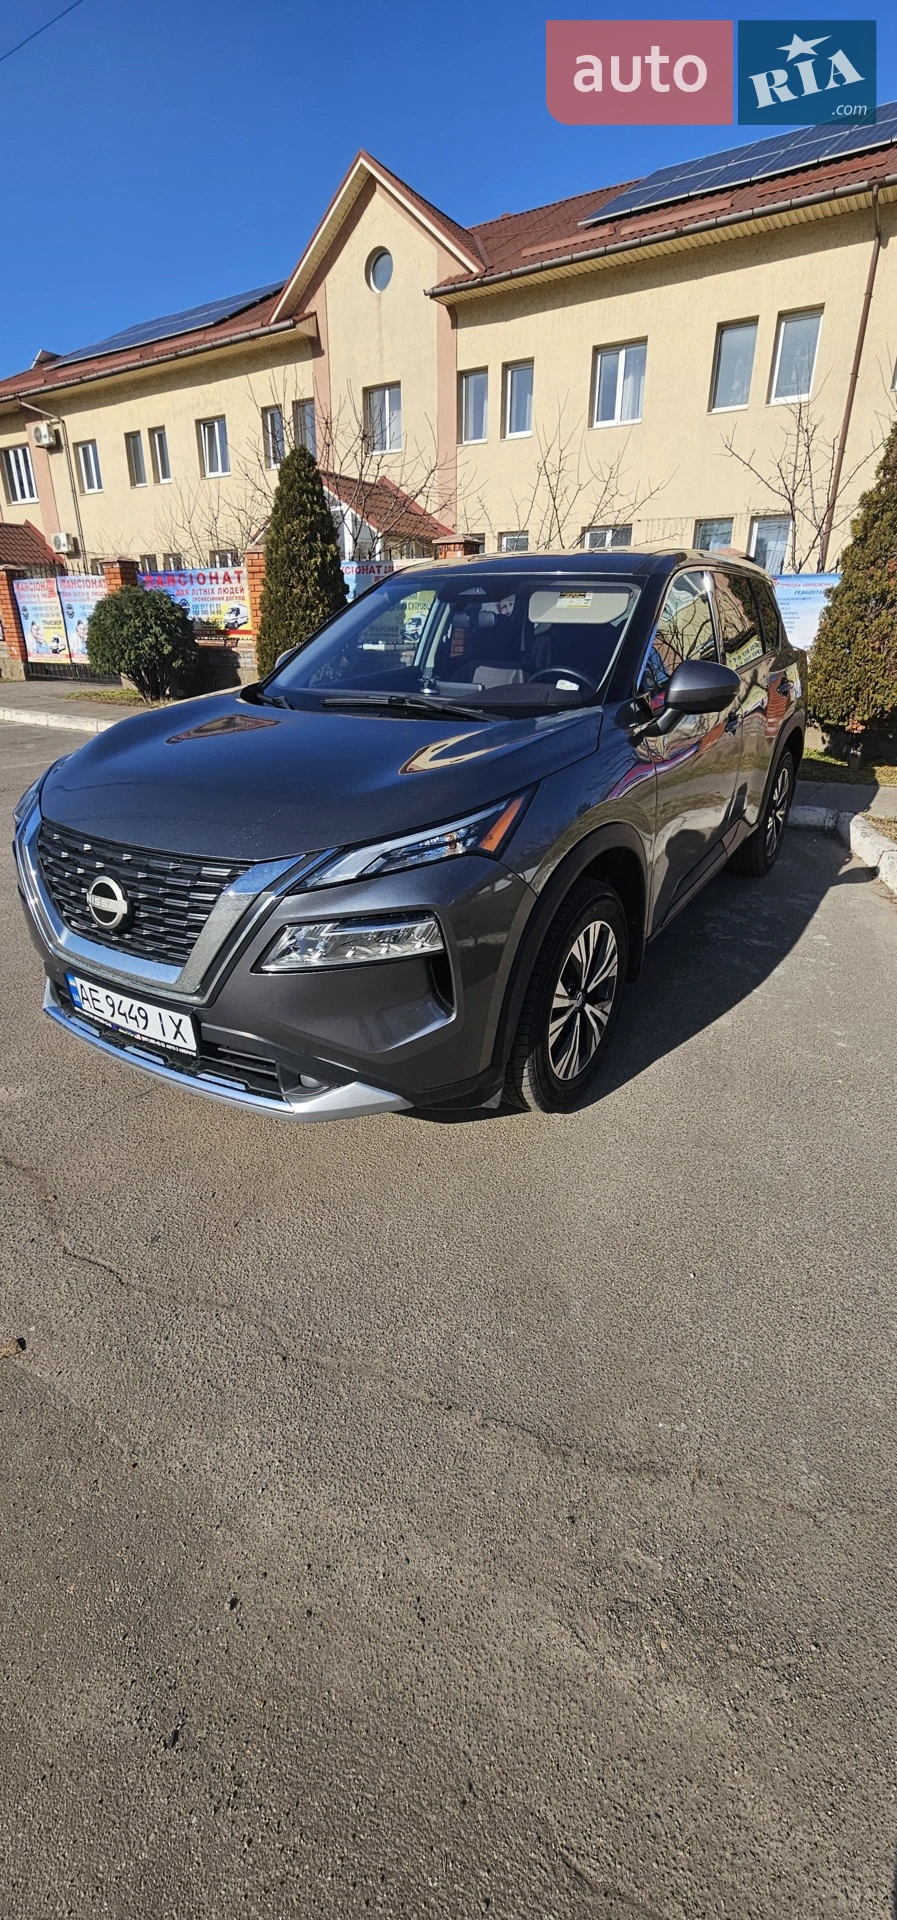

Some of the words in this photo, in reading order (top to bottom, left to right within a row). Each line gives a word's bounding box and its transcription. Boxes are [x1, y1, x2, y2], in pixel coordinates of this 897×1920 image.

[143, 570, 244, 588] ПАНСІОНАТ
[191, 587, 215, 597] ЛІТНІХ
[217, 585, 245, 595] ЛЮДЕЙ
[79, 983, 105, 1014] AE
[105, 994, 149, 1031] 9449
[158, 1012, 188, 1044] IX
